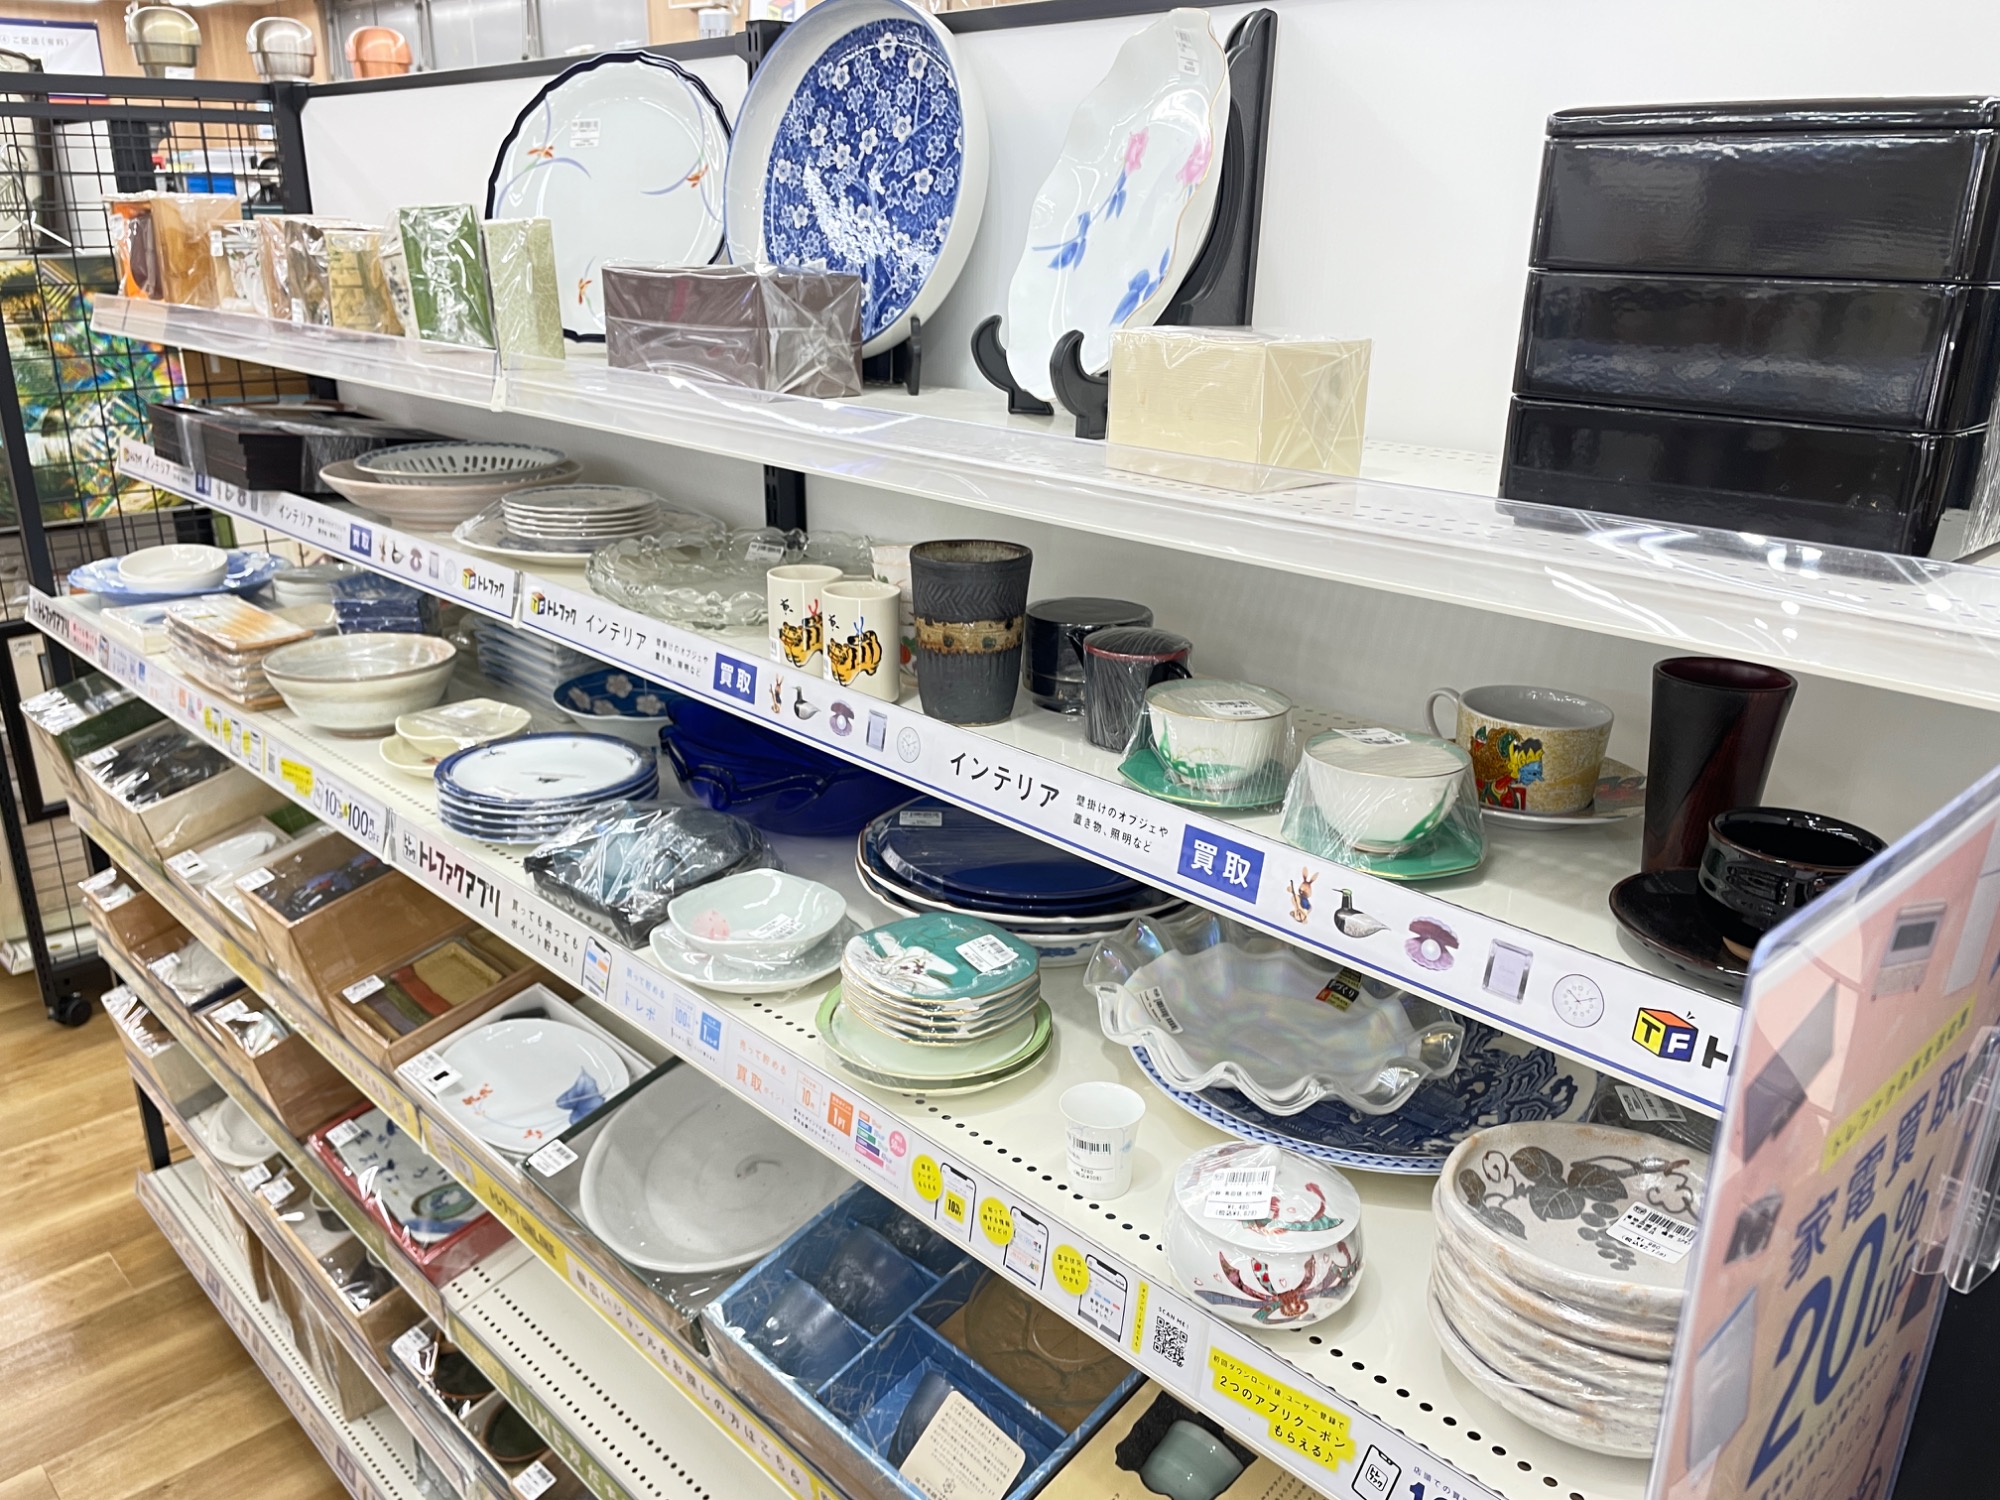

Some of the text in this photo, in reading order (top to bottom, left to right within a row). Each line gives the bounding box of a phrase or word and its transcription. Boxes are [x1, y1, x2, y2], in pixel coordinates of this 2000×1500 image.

[278, 504, 314, 528] インテリア
[352, 528, 370, 550] 買取
[477, 575, 505, 599] トレファク
[546, 599, 577, 626] トレファク
[585, 614, 647, 651] インテリア
[720, 661, 752, 696] 買取
[949, 752, 1060, 808] インテリア
[1072, 812, 1152, 853] 置き物、照明など
[1075, 793, 1169, 838] 壁掛けのオブジェや
[419, 840, 501, 918] トレファクアプリ
[1190, 838, 1252, 889] 買取
[511, 898, 578, 950] 買っても売っても
[625, 989, 656, 1021] トレポ
[1640, 1015, 1691, 1055] TF
[1158, 1306, 1176, 1321] SCAN
[1219, 1375, 1346, 1449] 2つのアプリクーポン
